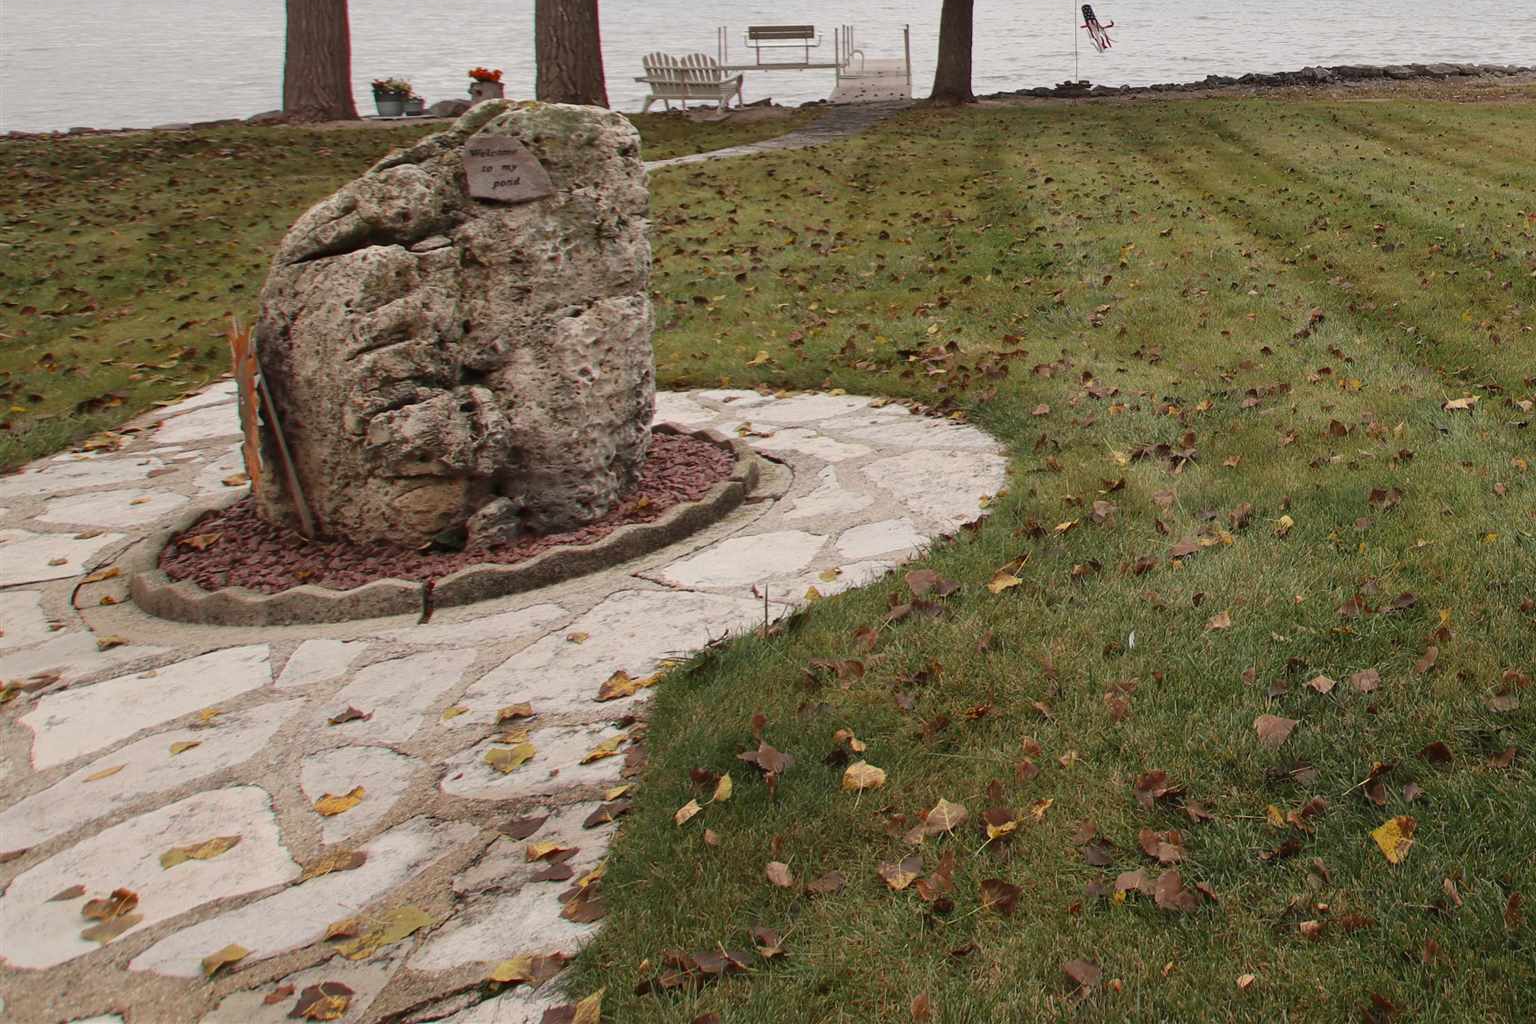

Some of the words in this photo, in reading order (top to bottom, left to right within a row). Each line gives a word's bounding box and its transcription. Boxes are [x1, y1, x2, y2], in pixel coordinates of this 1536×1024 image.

[481, 165, 493, 173] to
[501, 164, 517, 173] my
[492, 177, 521, 189] pond
